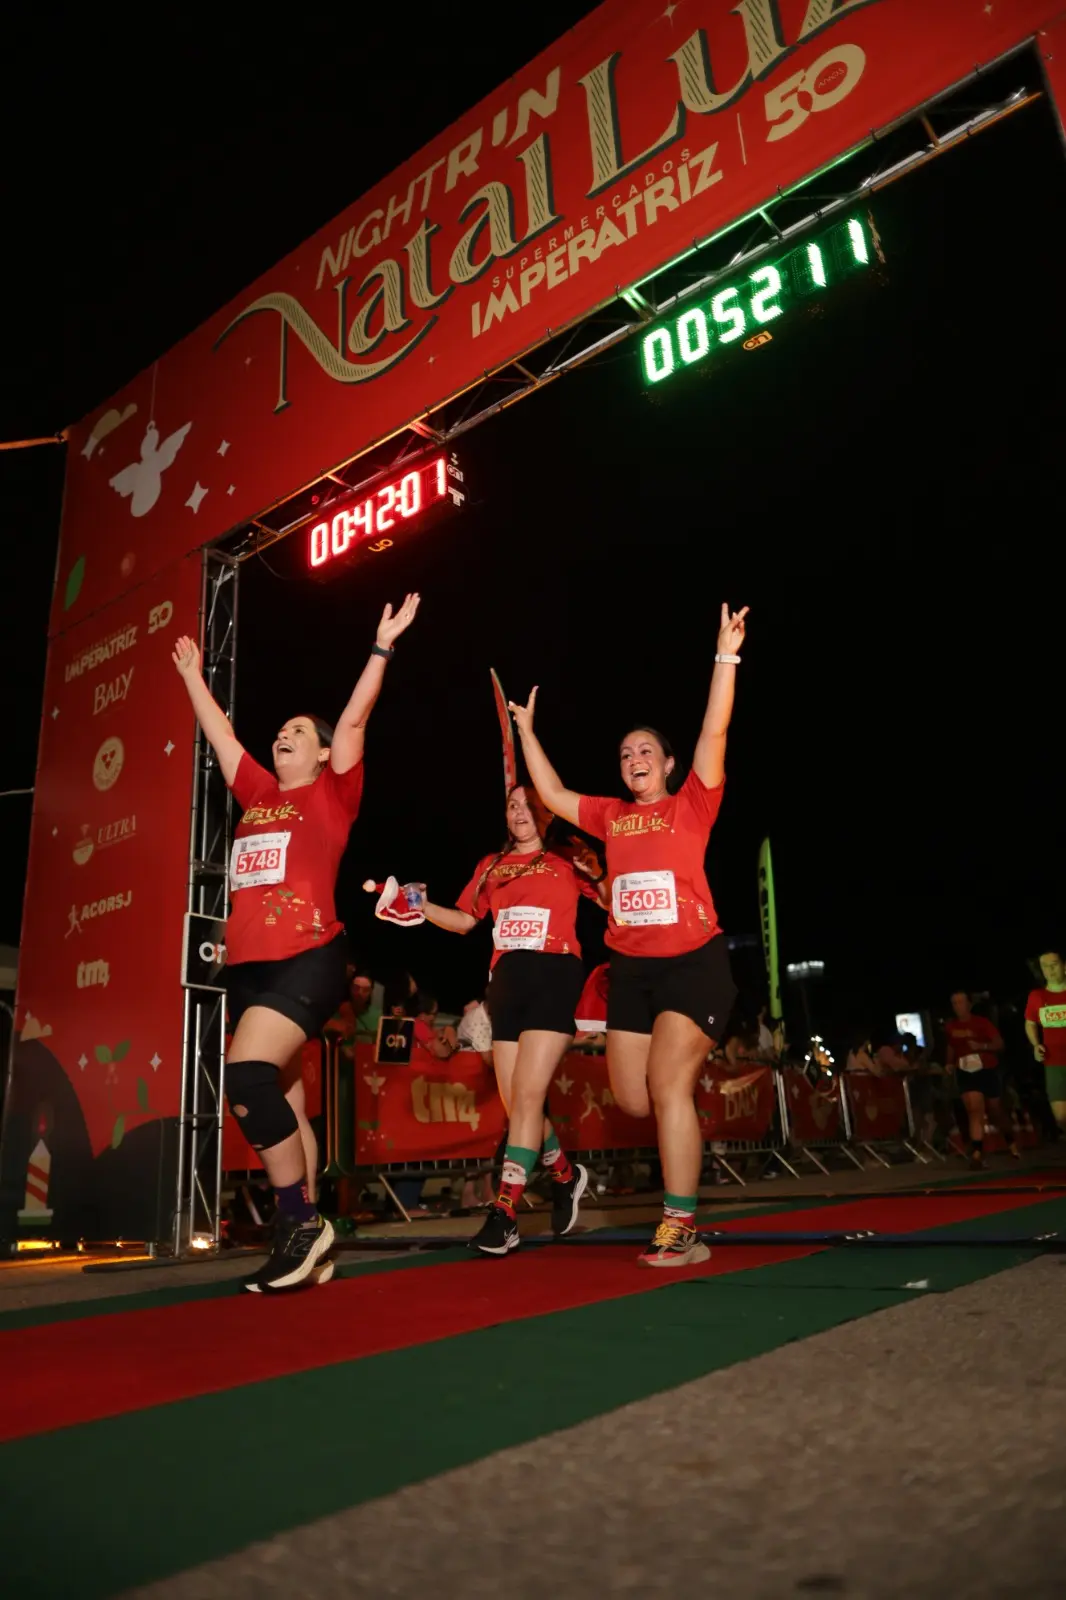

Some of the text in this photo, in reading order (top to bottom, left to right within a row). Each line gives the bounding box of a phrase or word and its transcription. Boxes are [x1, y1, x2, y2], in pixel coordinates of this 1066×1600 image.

[764, 43, 866, 143] 50
[315, 156, 446, 291] NIGHT
[471, 141, 723, 339] IMPERATRIZ
[492, 148, 691, 288] SUPERMERCADOS
[213, 132, 563, 415] Natal
[147, 601, 173, 634] 50
[65, 625, 138, 683] IMPERATRIZ
[93, 666, 135, 716] BALY
[238, 850, 279, 873] 5748
[501, 921, 542, 938] 5695
[621, 890, 669, 911] 5603
